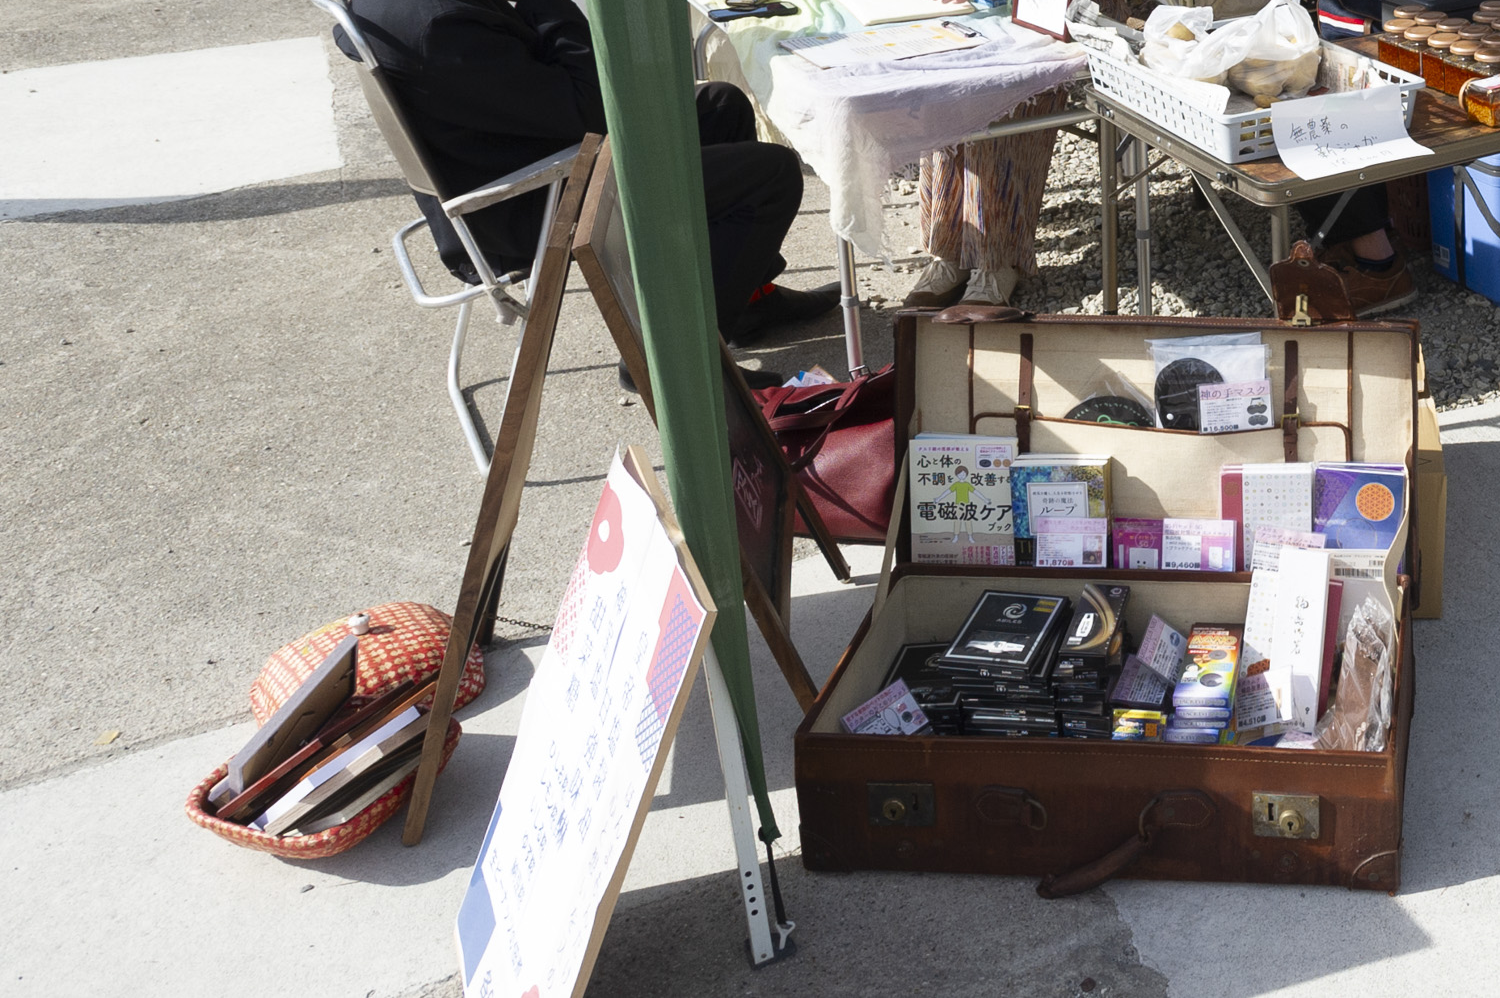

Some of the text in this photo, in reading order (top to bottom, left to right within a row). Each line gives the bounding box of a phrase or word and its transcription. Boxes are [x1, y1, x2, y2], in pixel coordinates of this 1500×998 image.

[917, 454, 962, 468] 心と体の
[917, 501, 1012, 521] 電磁波ケア
[1040, 503, 1078, 516] ループ
[988, 522, 1012, 532] ブック
